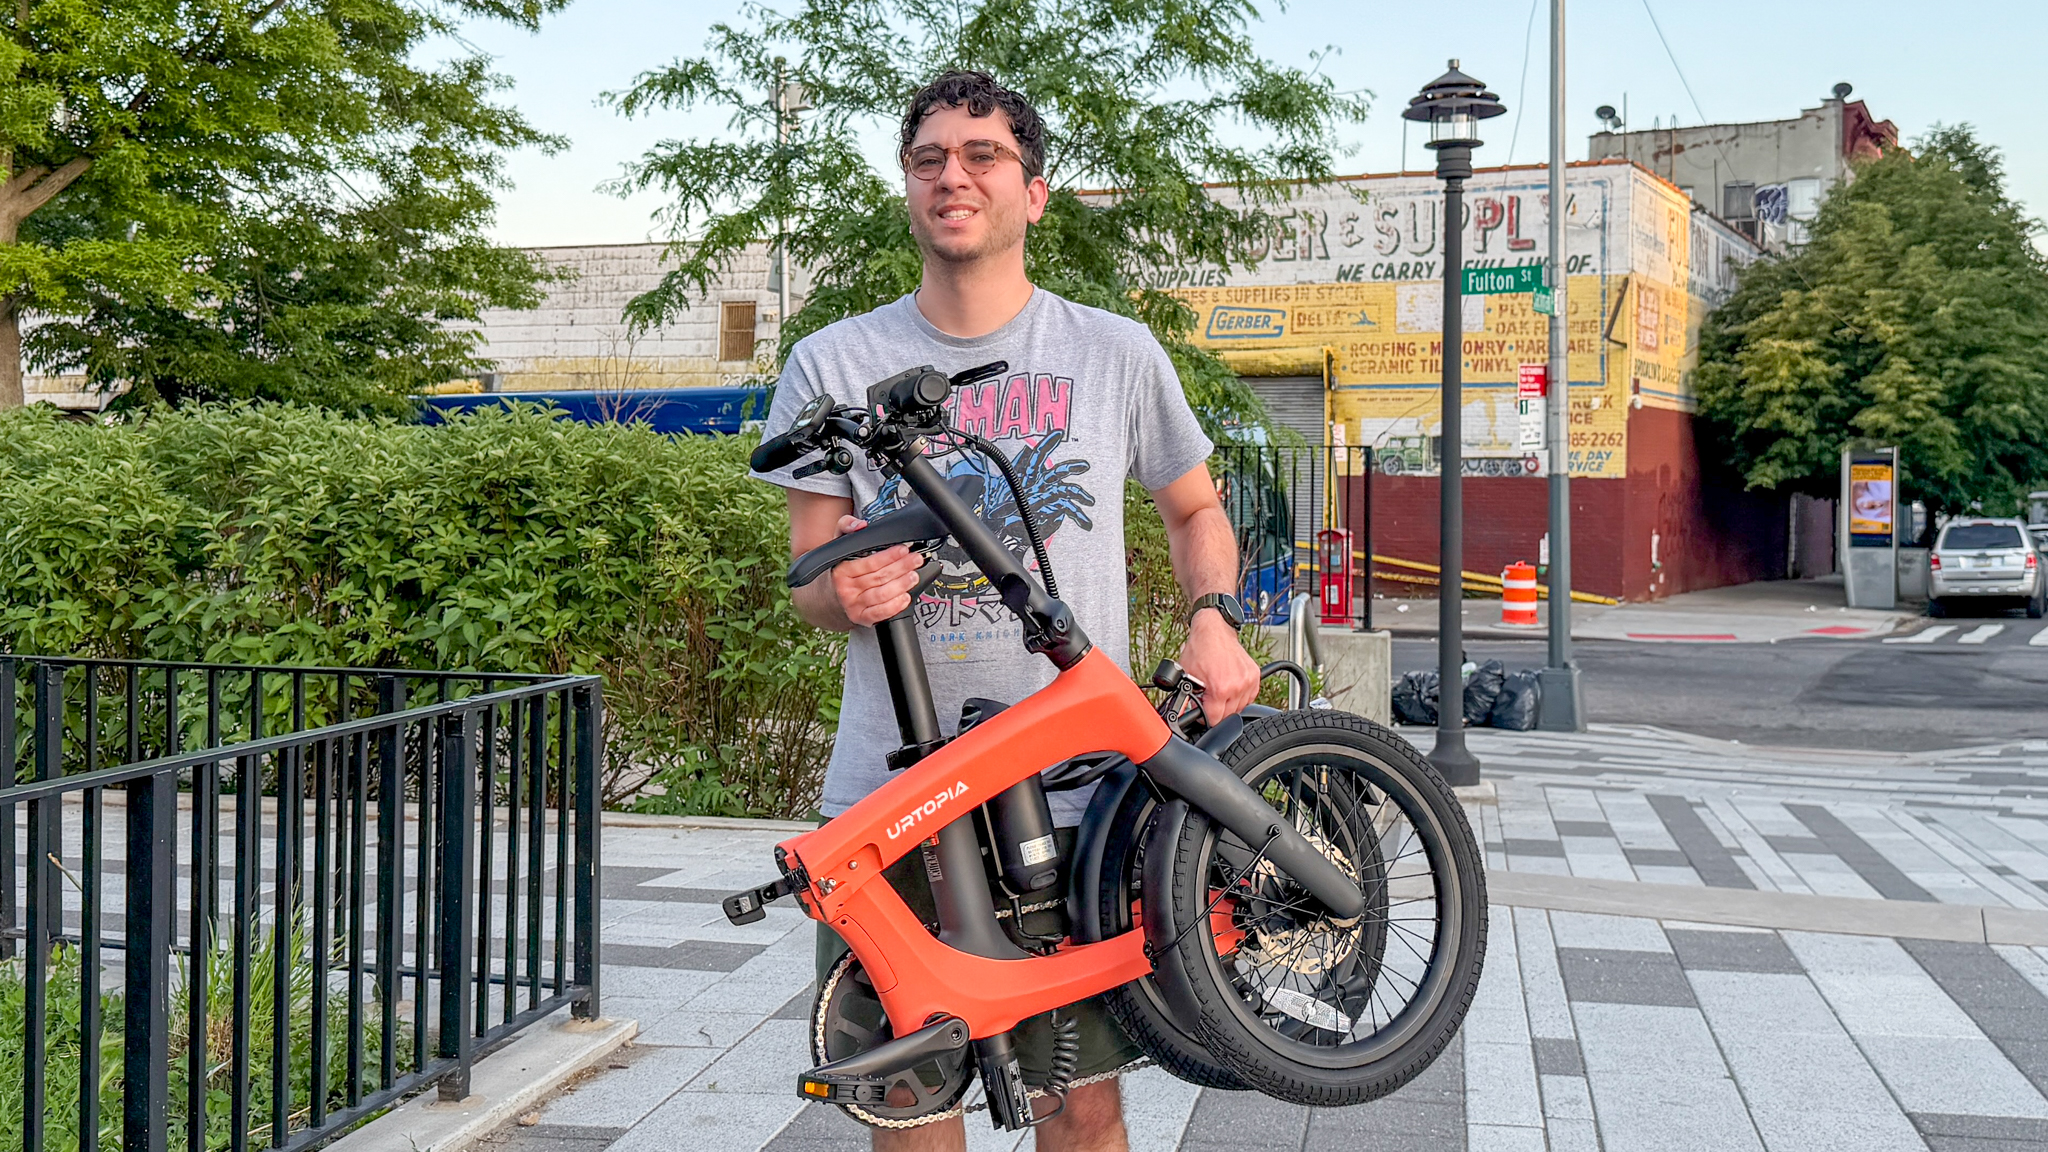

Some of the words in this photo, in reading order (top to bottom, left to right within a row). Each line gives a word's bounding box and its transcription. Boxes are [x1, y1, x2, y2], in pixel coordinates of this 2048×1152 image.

[1147, 267, 1226, 289] SUPPLIES
[1335, 263, 1365, 282] WE
[1371, 261, 1436, 280] CARRY
[1468, 271, 1515, 292] Fulton
[1521, 268, 1532, 282] St
[1226, 287, 1290, 303] SUPPLIES
[1295, 286, 1310, 301] IN
[1216, 311, 1272, 331] GERBER
[1495, 320, 1530, 336] OAK
[1350, 342, 1417, 358] ROOFING
[1430, 339, 1506, 357] MONRY
[1515, 339, 1595, 355] HARARE
[1350, 359, 1414, 375] CERAMIC
[1420, 358, 1443, 374] TIL
[1471, 357, 1513, 373] VINYL
[1568, 432, 1624, 447] 85-2262
[930, 632, 965, 643] DARK
[975, 627, 1021, 641] KNIGH
[886, 780, 970, 840] URTOPIA
